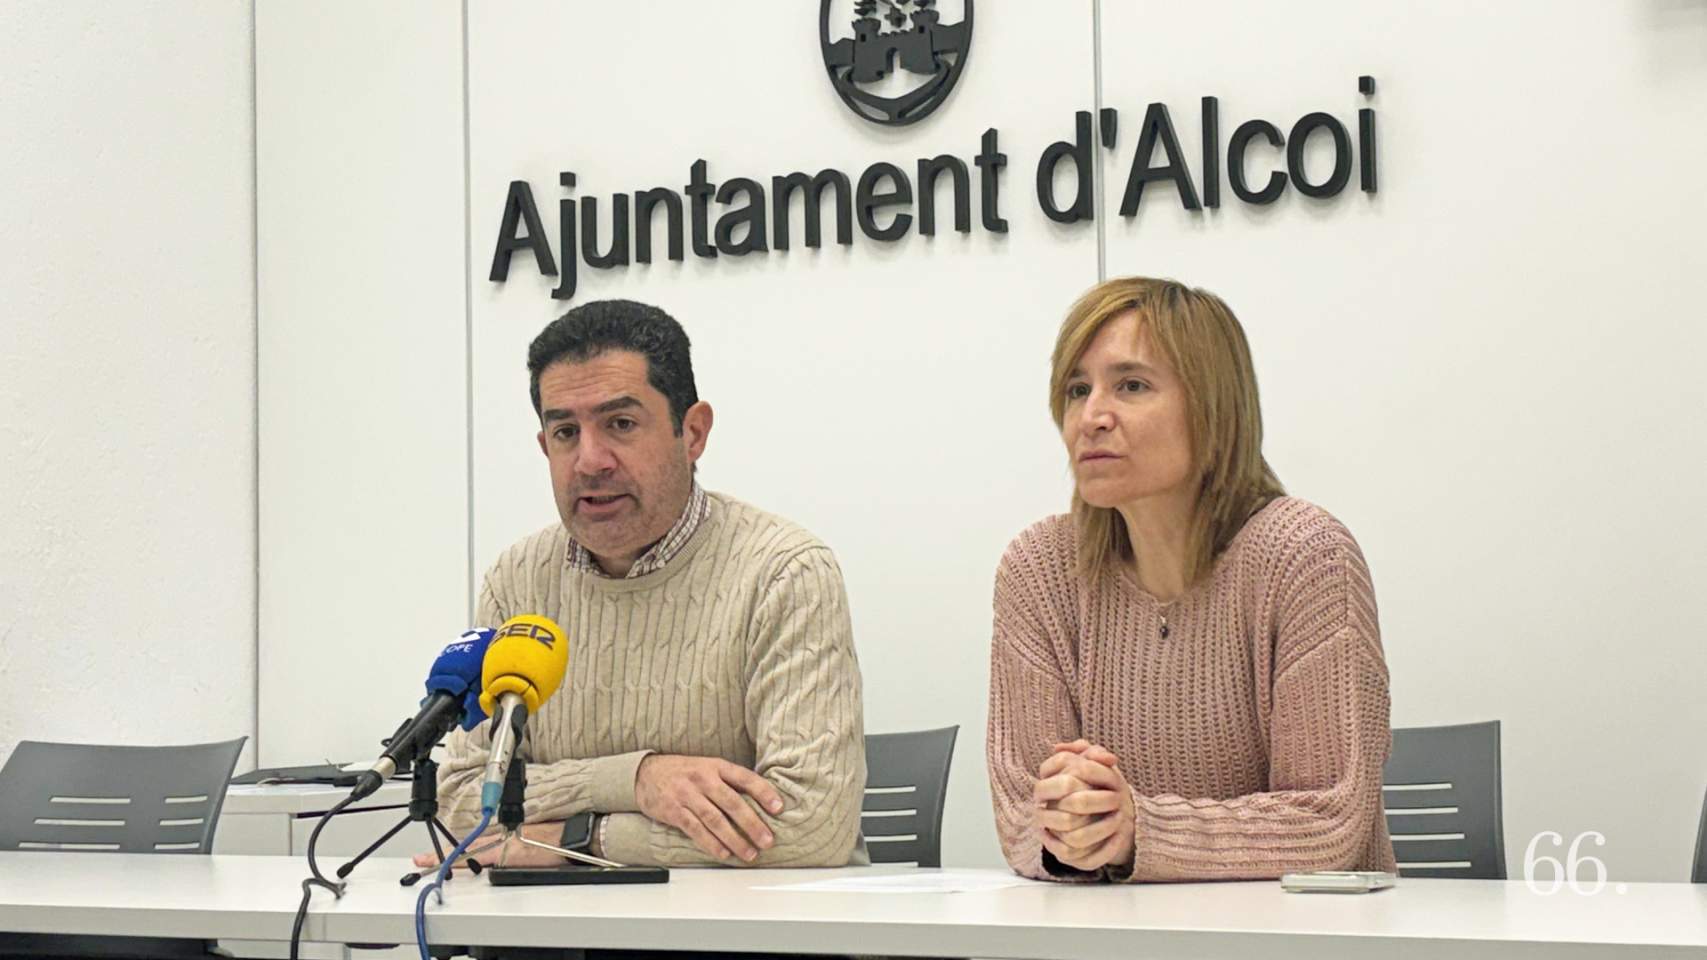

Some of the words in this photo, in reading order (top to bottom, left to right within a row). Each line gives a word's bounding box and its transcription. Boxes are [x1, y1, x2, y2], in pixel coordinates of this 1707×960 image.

[489, 128, 1008, 299] Ajuntament
[1036, 75, 1377, 223] d'Alcoi
[442, 643, 473, 655] OPE
[489, 623, 556, 650] SER
